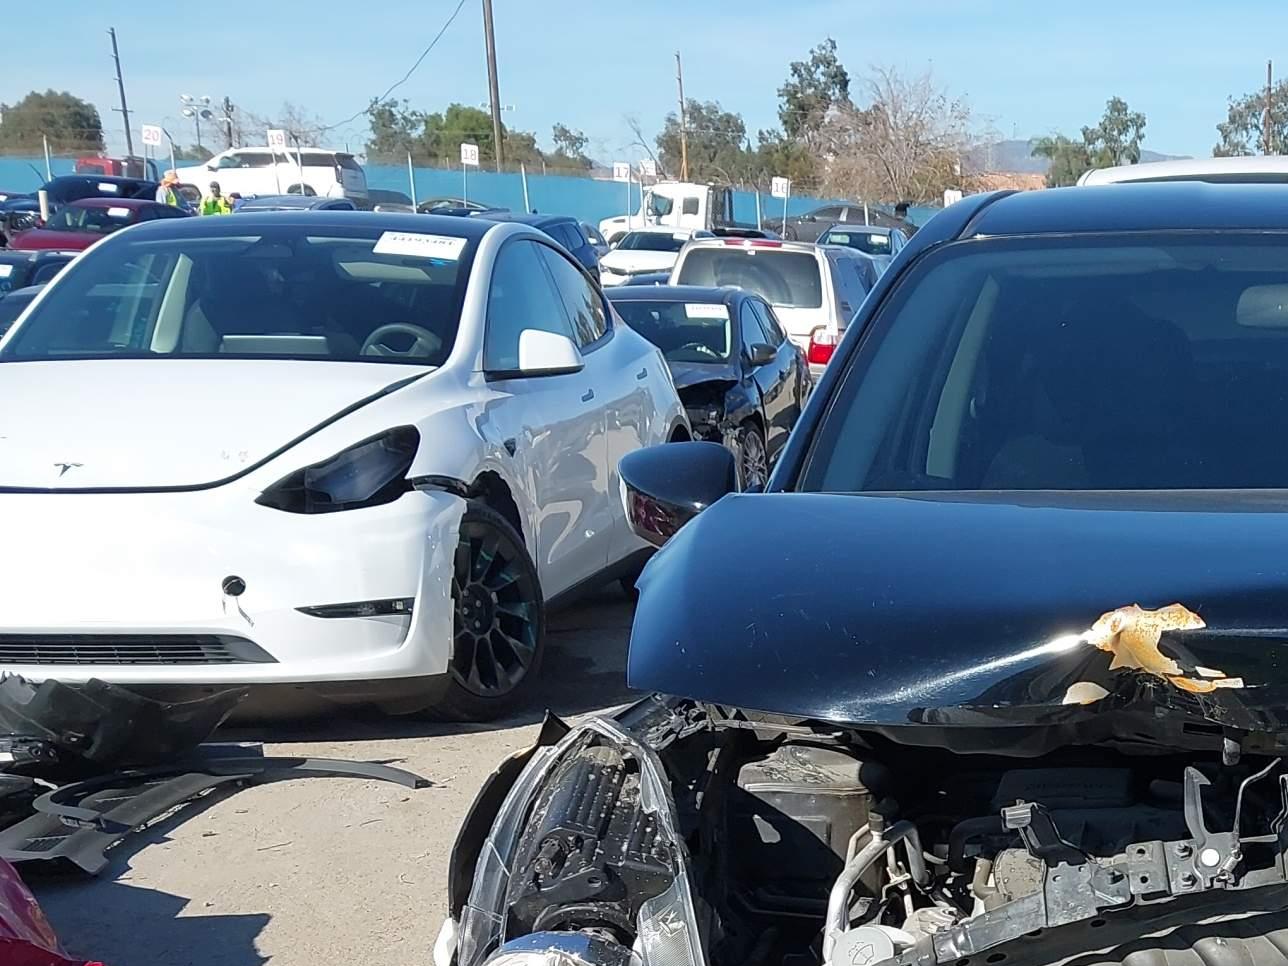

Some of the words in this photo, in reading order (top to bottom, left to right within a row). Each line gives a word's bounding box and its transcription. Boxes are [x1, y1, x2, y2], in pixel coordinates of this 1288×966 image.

[144, 128, 160, 142] 20
[270, 133, 284, 145] 19
[615, 166, 629, 178] 17
